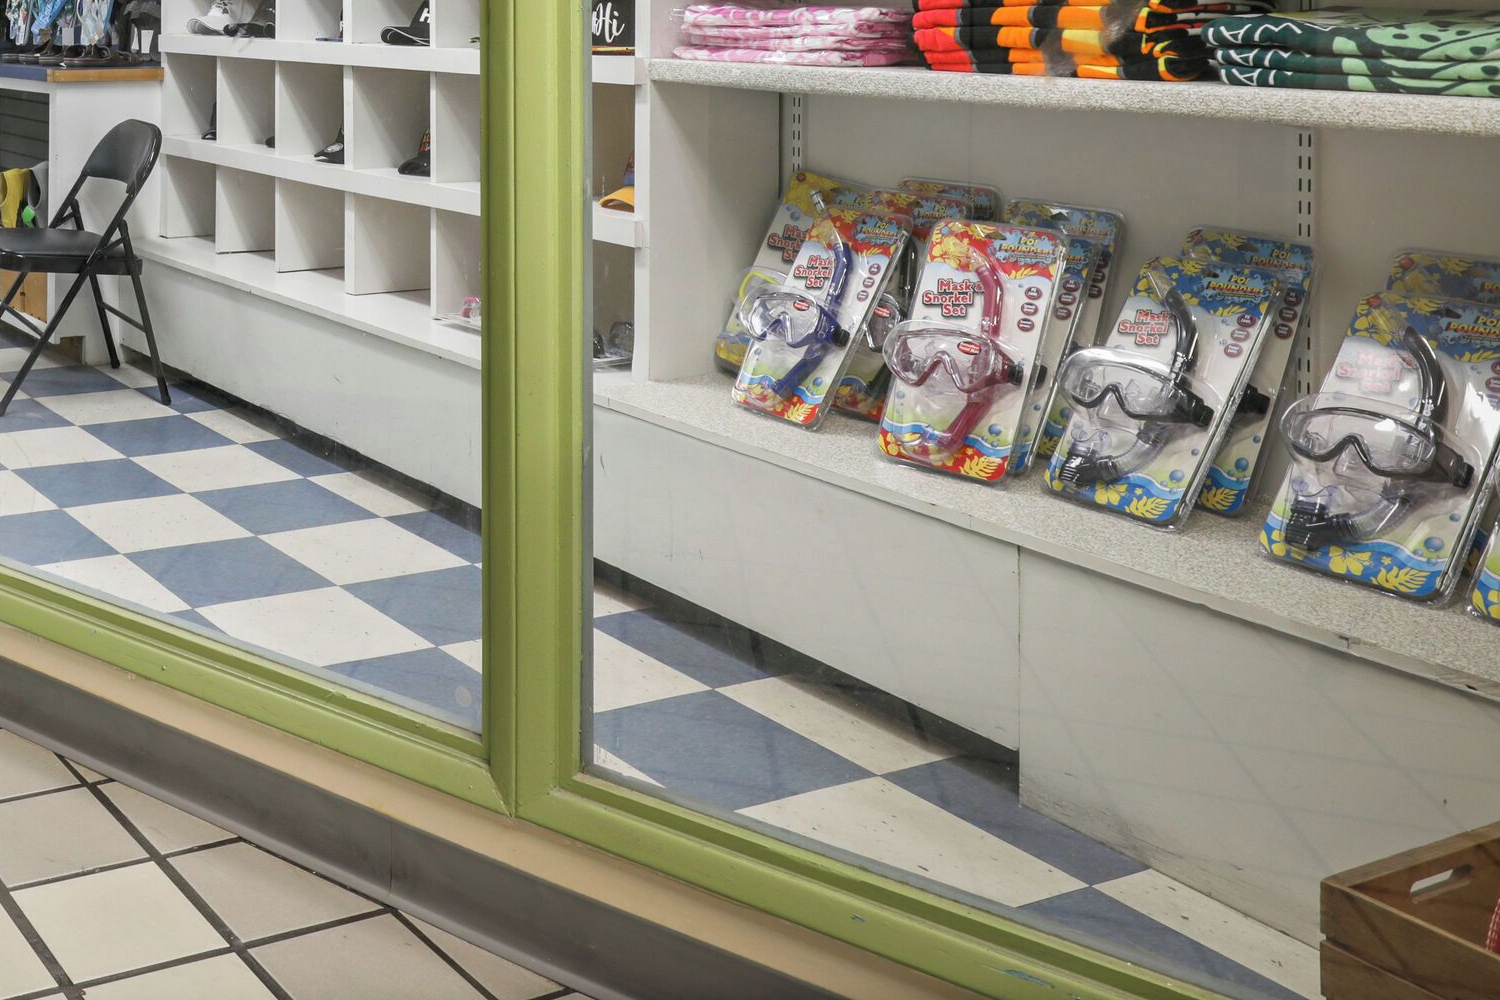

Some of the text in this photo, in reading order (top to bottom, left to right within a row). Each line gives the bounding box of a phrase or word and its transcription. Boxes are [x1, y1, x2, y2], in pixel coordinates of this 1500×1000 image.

[783, 224, 808, 239] Mas
[1020, 236, 1038, 246] POI
[782, 249, 799, 263] Se
[794, 265, 832, 278] Snorkel
[805, 276, 825, 289] Set
[938, 279, 972, 292] Mask
[1231, 274, 1250, 285] POI
[923, 291, 973, 304] Snorkel
[942, 304, 966, 316] Set
[1136, 310, 1169, 322] Mask
[1118, 319, 1169, 333] Snorkel
[1136, 333, 1160, 345] Set
